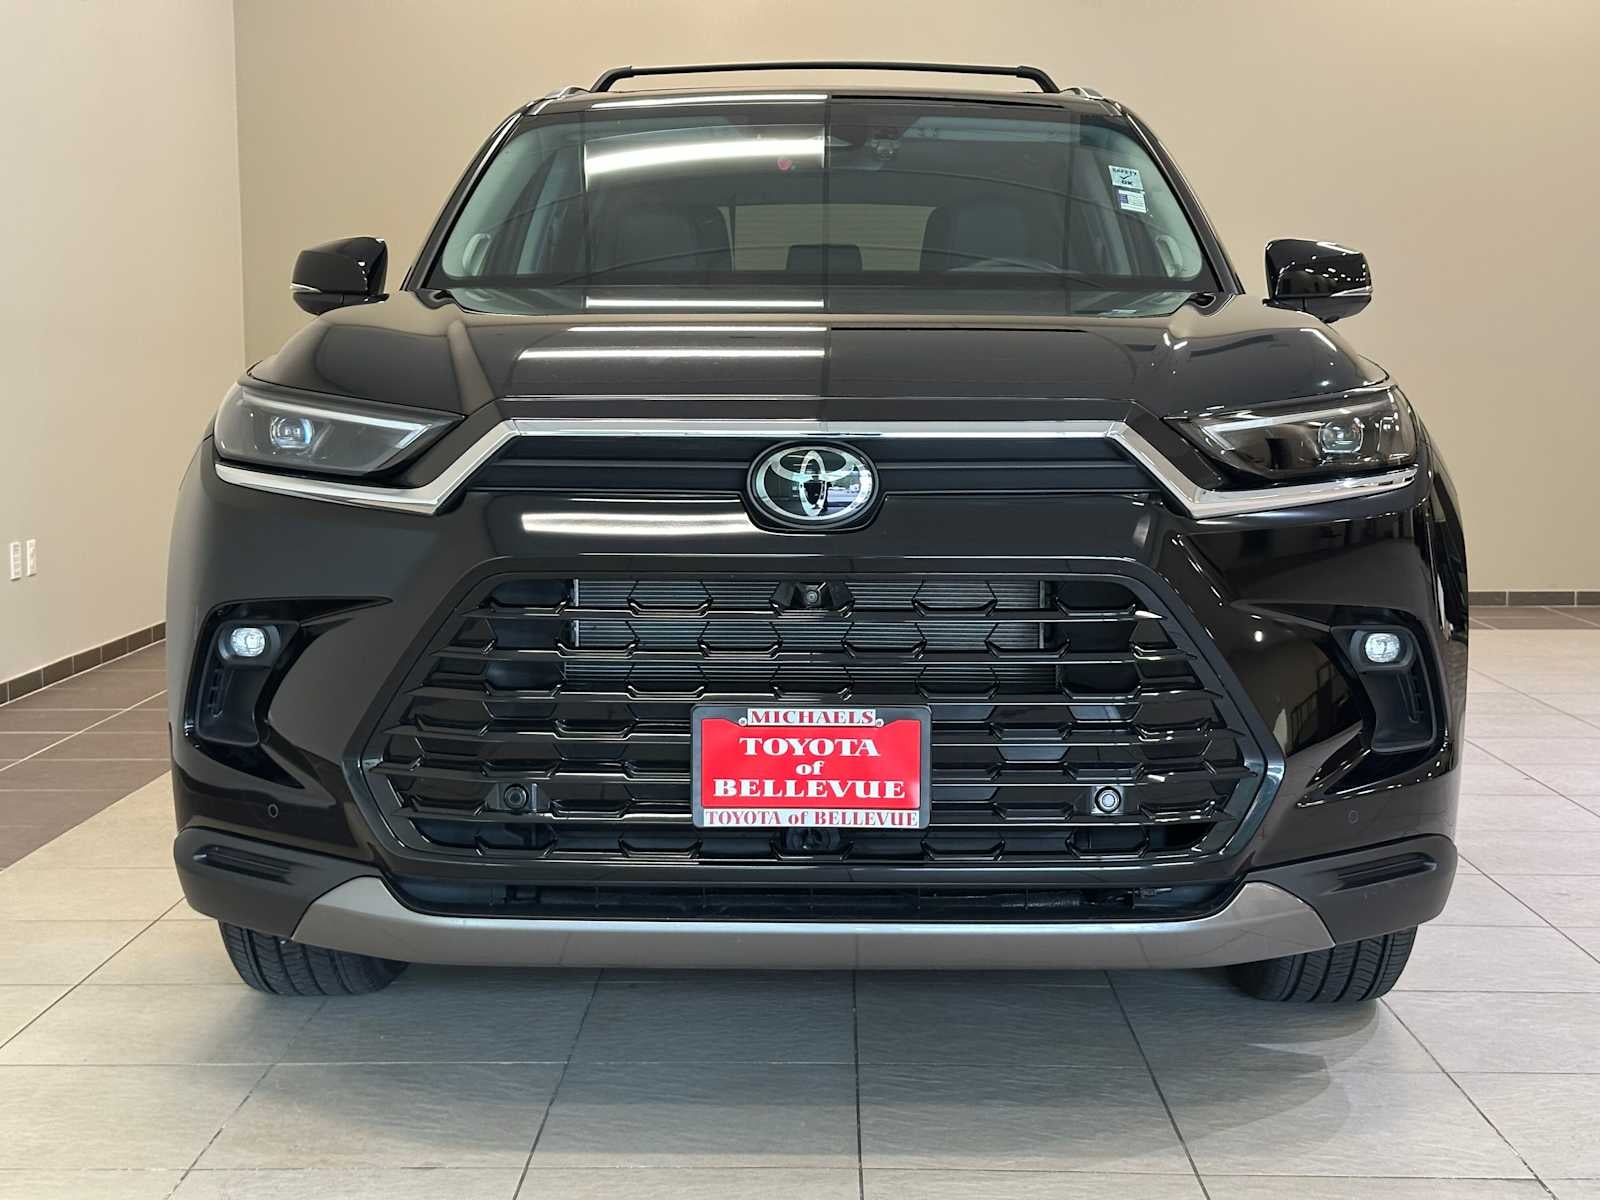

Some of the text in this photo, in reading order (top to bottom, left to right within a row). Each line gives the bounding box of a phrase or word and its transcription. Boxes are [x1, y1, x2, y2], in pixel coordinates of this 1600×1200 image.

[751, 710, 874, 725] MICHAELS
[739, 738, 880, 757] TOYOTA
[795, 760, 825, 776] of
[713, 779, 905, 799] BELLEVUE
[706, 810, 918, 826] TOYOTA of BELLEVUE
